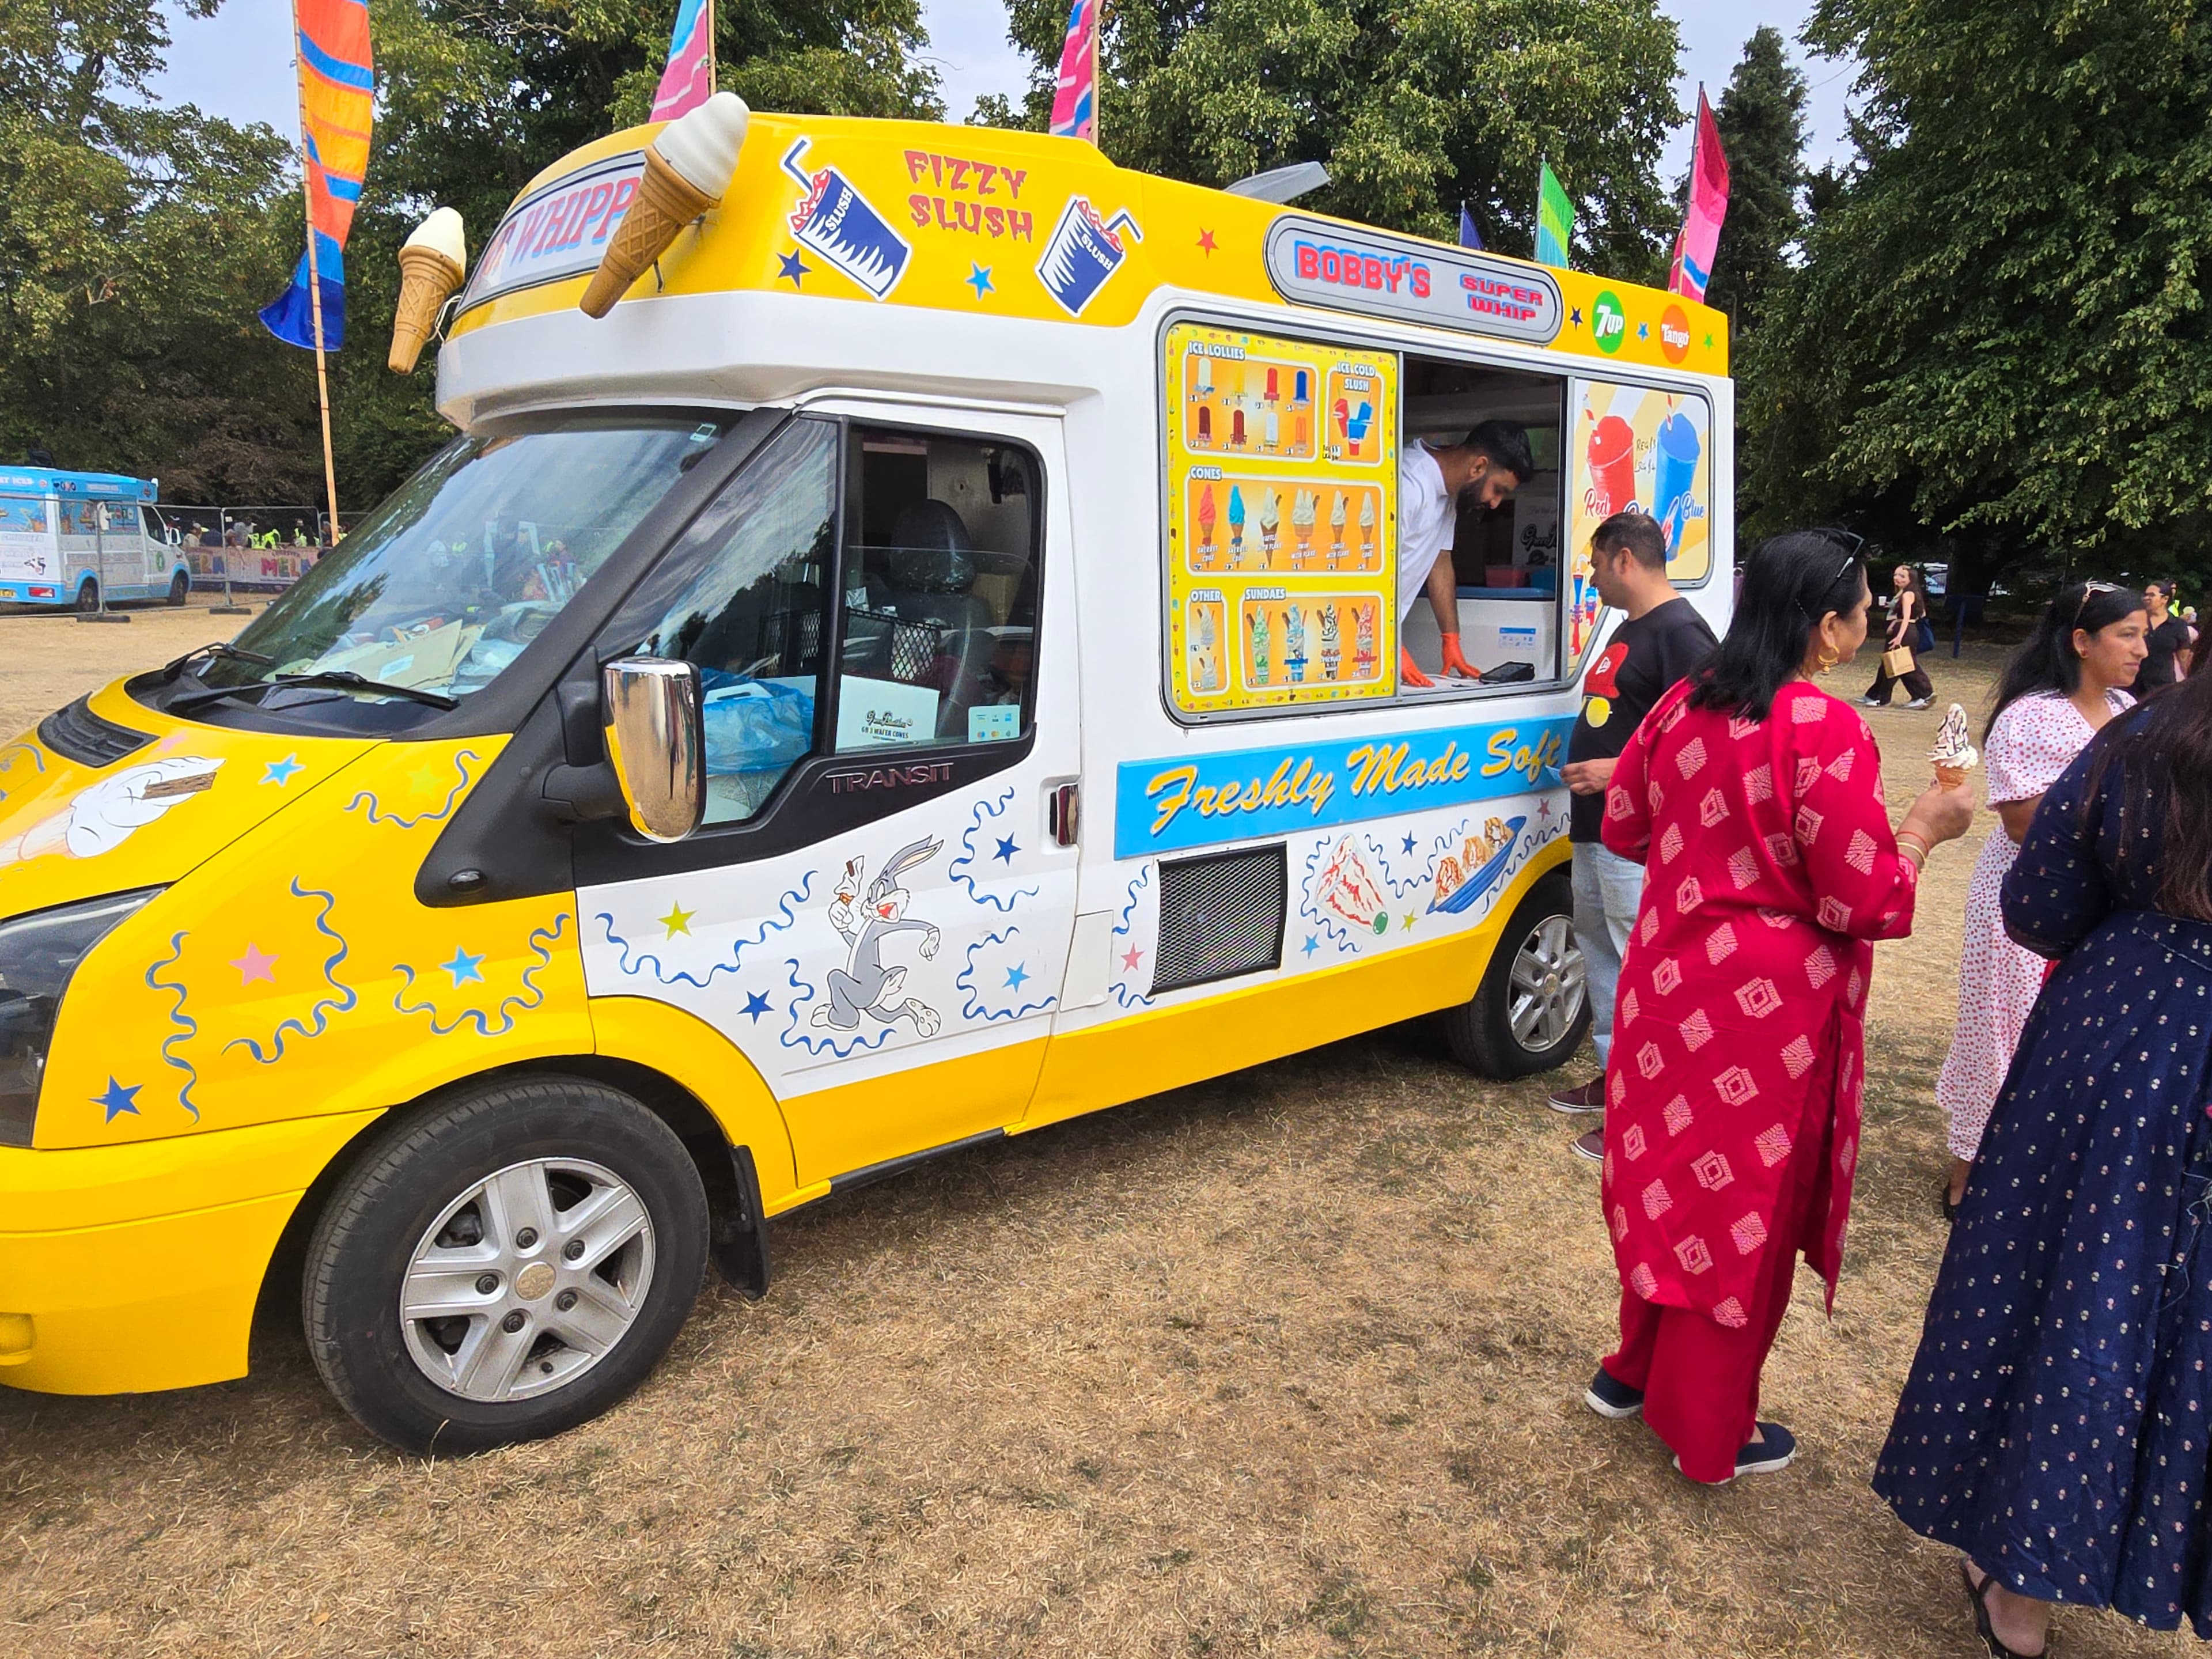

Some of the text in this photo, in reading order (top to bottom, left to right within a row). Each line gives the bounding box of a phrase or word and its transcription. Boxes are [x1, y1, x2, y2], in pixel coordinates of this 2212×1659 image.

[904, 150, 1027, 199] FIZZY
[510, 177, 642, 267] WHIPP
[825, 186, 853, 232] SLUSH
[908, 195, 1033, 243] SLUSH
[1081, 233, 1114, 271] SLUSH
[1294, 240, 1431, 298] BOBBY'S
[1460, 273, 1543, 306] SUPER
[1468, 293, 1536, 321] WHIP
[1661, 323, 1690, 349] Tango
[1188, 341, 1245, 361] ICE LOLLIES
[1337, 361, 1376, 377] ICE COLD
[1344, 378, 1369, 392] SLUSH
[1191, 466, 1222, 480] CONES
[1584, 488, 1611, 518] Red
[1681, 491, 1704, 520] Blue
[1191, 590, 1221, 603] OTHER
[1245, 588, 1286, 600] SUNDAES
[892, 730, 909, 738] CONES
[825, 762, 955, 794] TRANSIT
[1146, 728, 1562, 838] Freshly Made Soft
